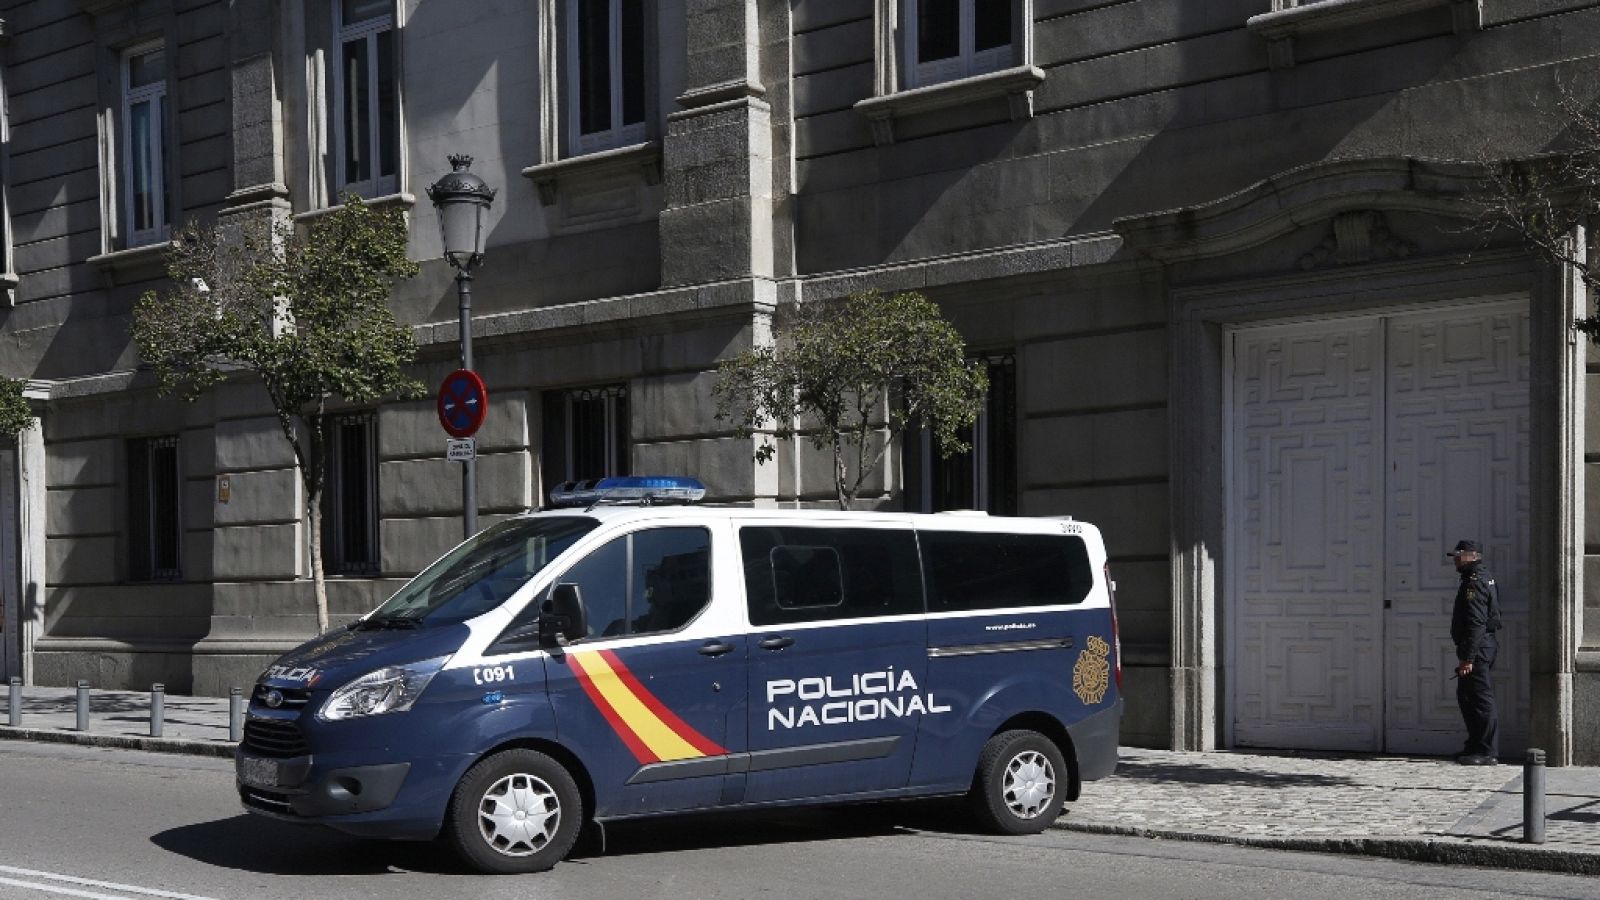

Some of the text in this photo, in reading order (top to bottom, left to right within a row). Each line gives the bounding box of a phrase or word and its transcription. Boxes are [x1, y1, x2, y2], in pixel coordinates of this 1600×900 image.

[482, 664, 515, 682] 091
[766, 665, 918, 703] POLICÍA
[768, 693, 952, 731] NACIONAL
